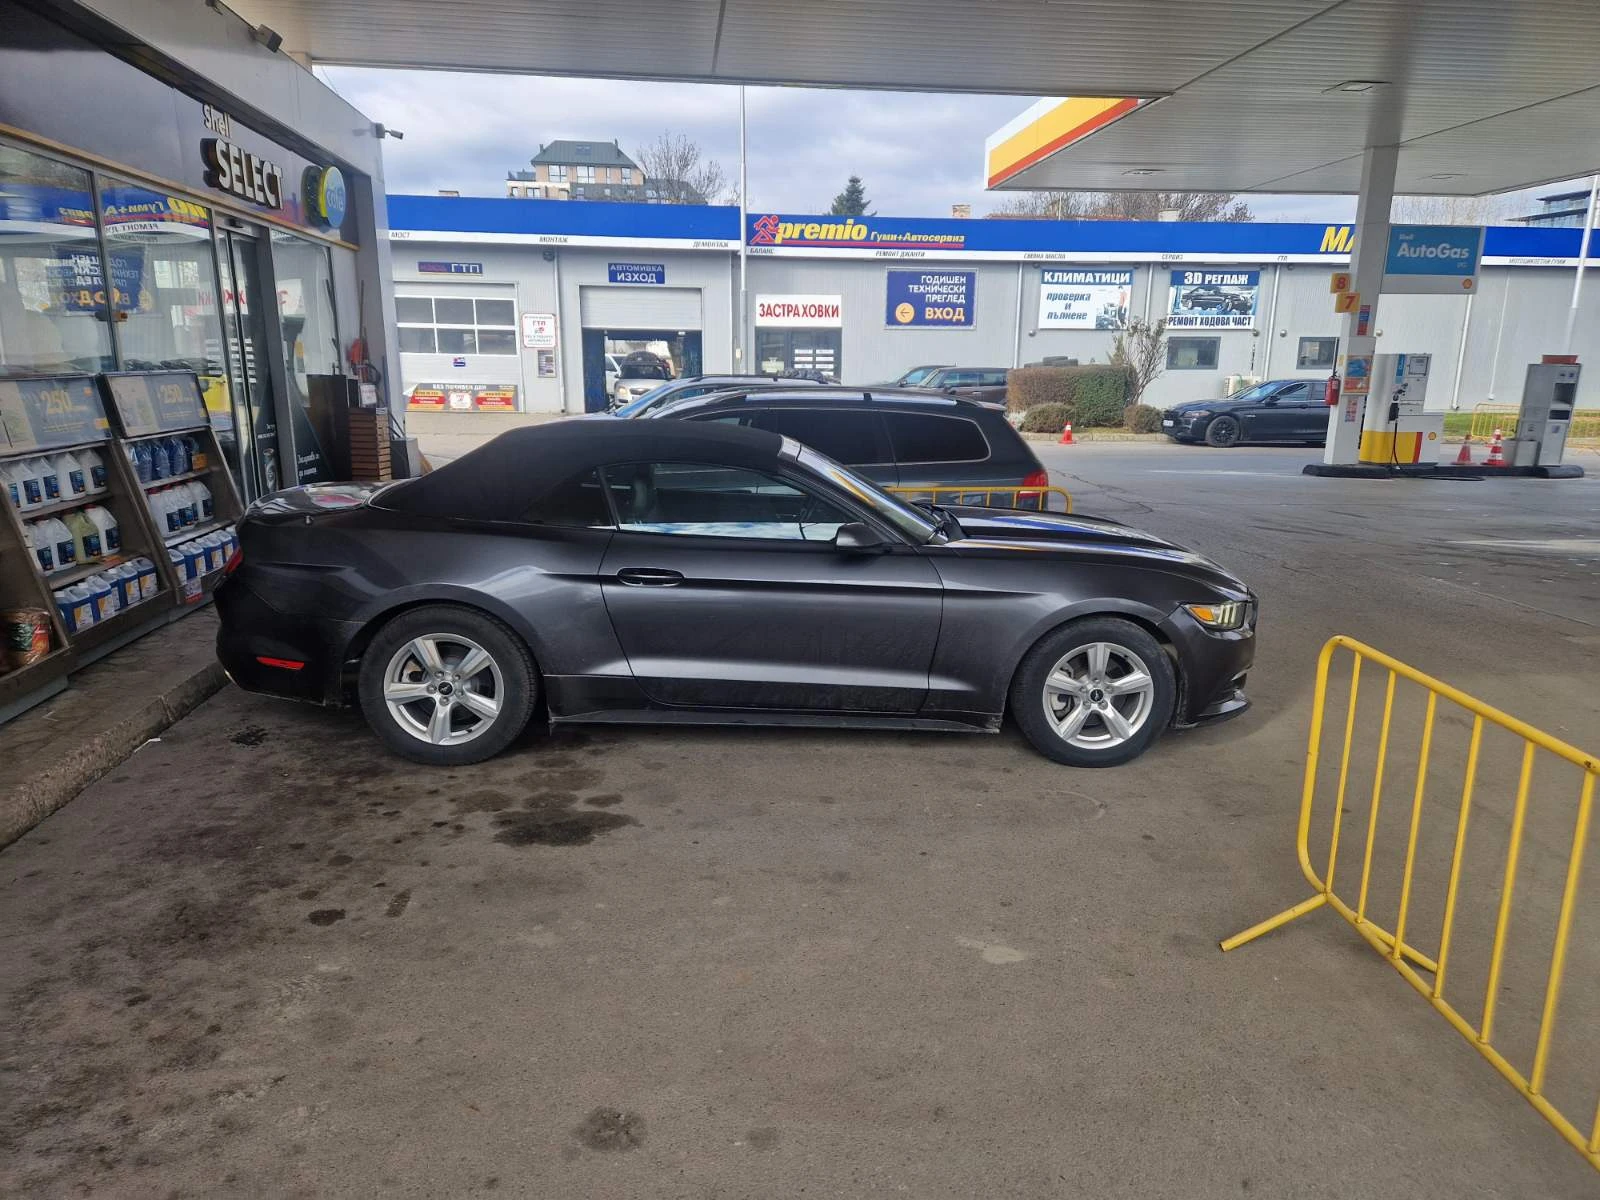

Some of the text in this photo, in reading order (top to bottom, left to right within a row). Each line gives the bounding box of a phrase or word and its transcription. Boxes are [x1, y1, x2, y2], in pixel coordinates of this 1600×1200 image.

[202, 104, 230, 138] Shell
[216, 138, 283, 209] SELECT
[775, 218, 868, 244] premio
[538, 236, 568, 244] МОНТАЖ
[870, 231, 965, 244] Гуми+Автосервиз
[1397, 243, 1470, 260] AutoGas
[451, 264, 481, 272] ГТП
[610, 264, 664, 272] АВТОМИВКА
[616, 272, 656, 283] ИЗХОД
[921, 275, 966, 285] ГОДИШЕН
[1044, 271, 1130, 284] КЛИМАТИЦИ
[1184, 272, 1249, 284] 3D РЕГЛАЖ
[908, 284, 966, 294] ТЕХНИЧЕСКИ
[1336, 277, 1346, 290] 8
[925, 294, 966, 304] ПРЕГЛЕД
[1046, 292, 1092, 302] проверка
[1344, 296, 1356, 310] 7
[924, 306, 965, 322] ВХОД
[1047, 312, 1088, 320] пълнене
[1168, 316, 1252, 327] РЕМОНТ ХОДОВА ЧАСТ
